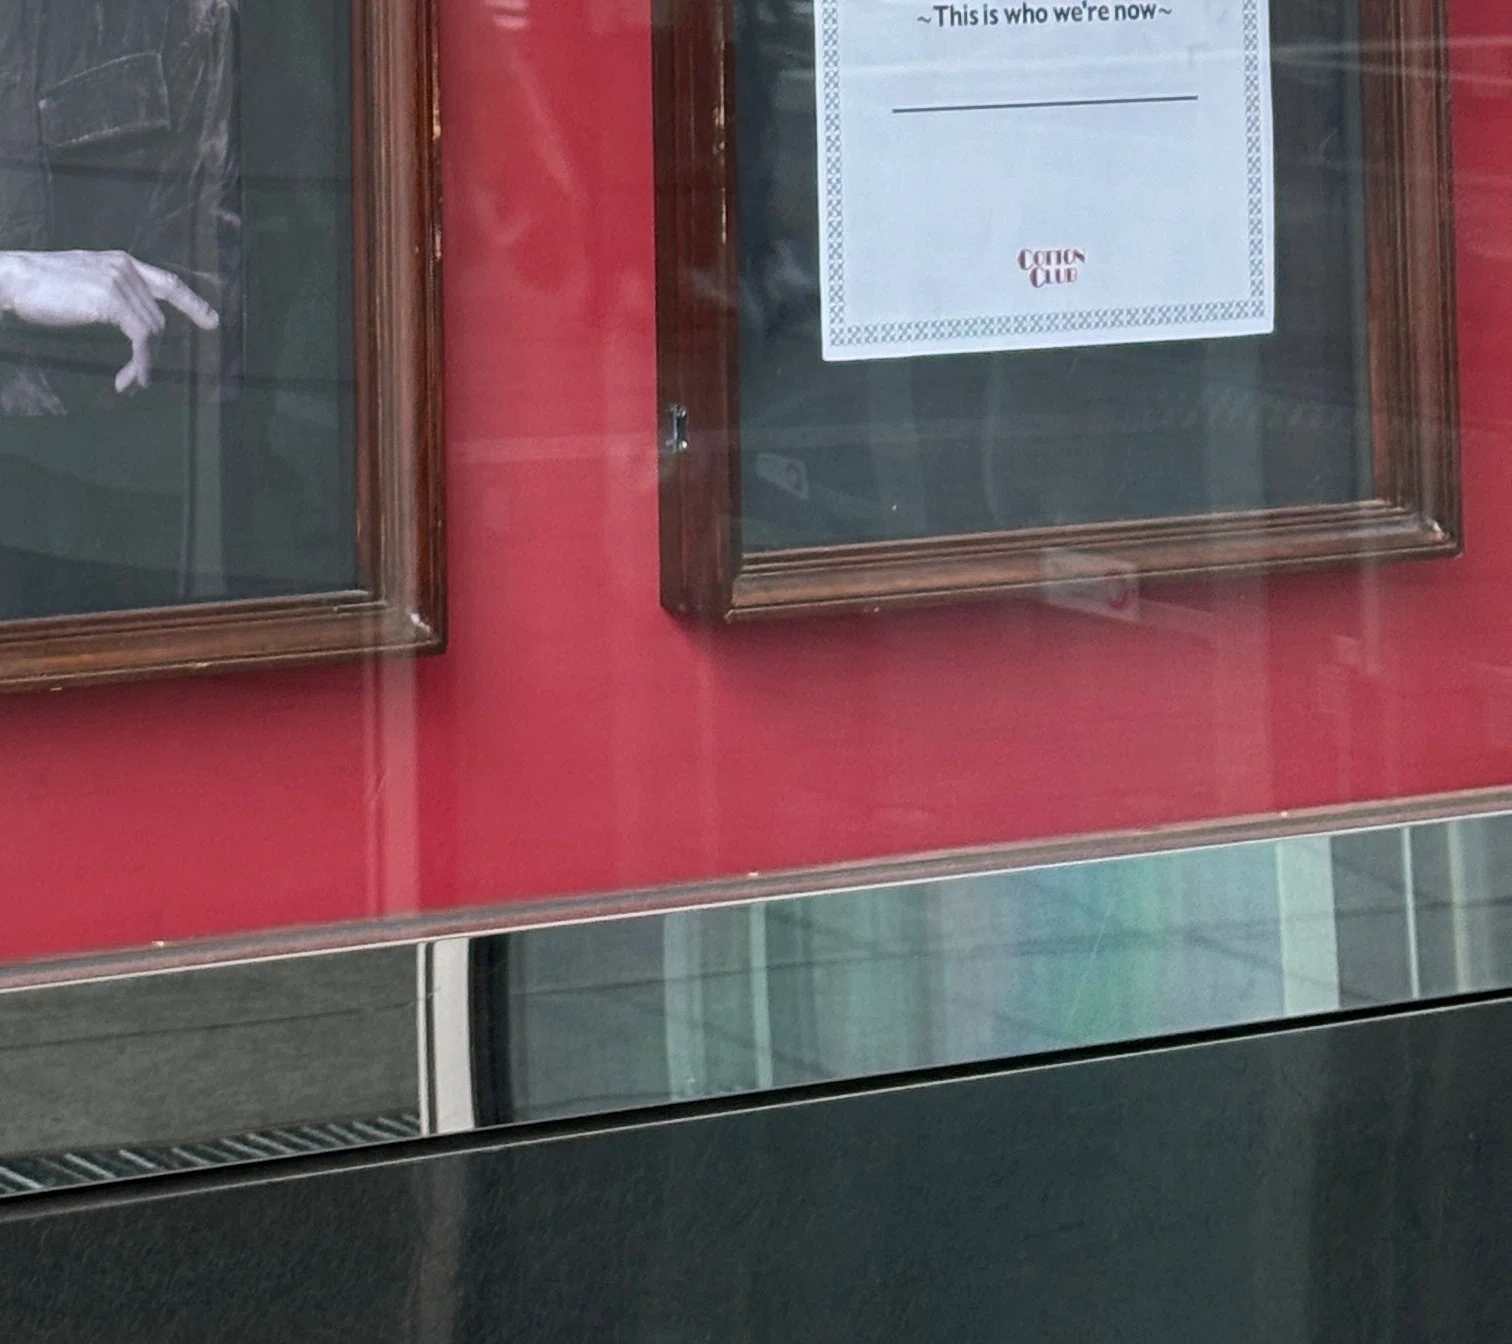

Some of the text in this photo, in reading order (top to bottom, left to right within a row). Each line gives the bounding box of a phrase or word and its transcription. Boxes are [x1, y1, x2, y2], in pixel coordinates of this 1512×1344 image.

[983, 2, 999, 26] is
[1004, 1, 1048, 24] who
[1053, 0, 1110, 22] we're
